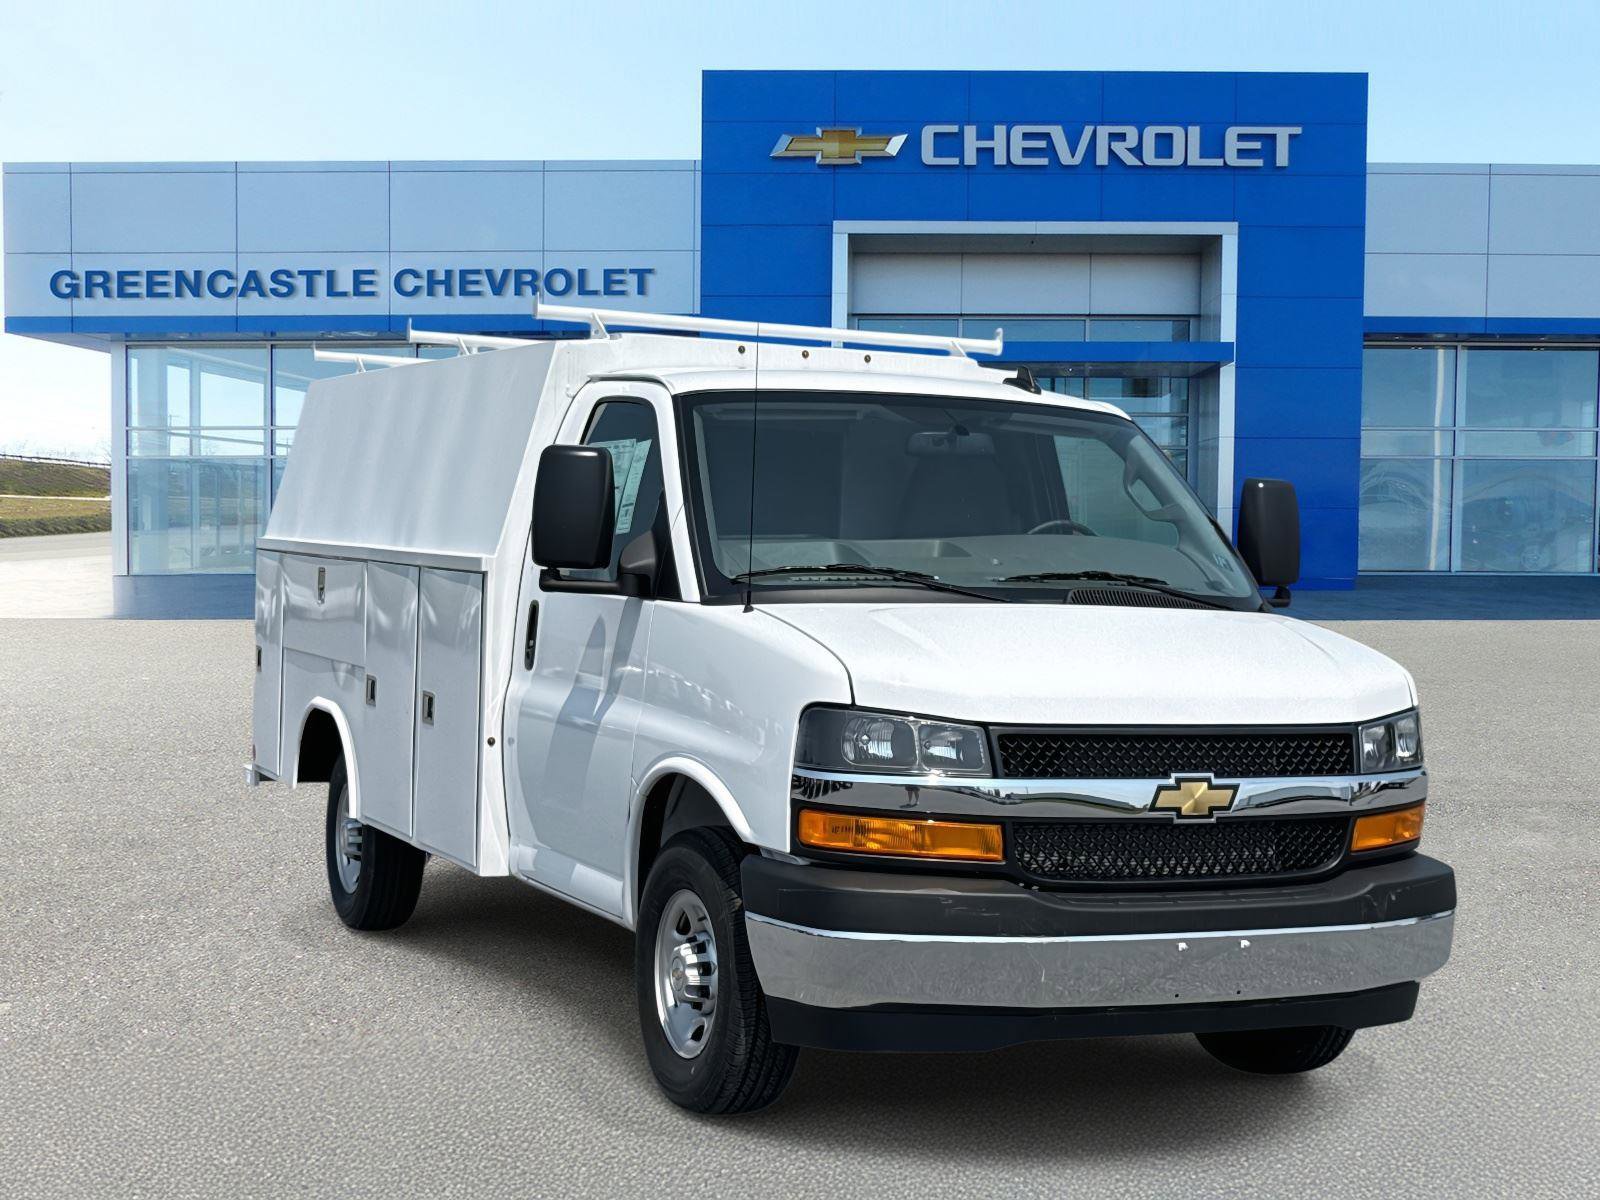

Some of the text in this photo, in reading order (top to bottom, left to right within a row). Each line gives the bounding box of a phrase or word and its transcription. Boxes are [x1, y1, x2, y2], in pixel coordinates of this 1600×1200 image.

[921, 125, 1303, 168] CHEVROLET
[49, 267, 655, 299] GREENCASTLE CHEVROLET
